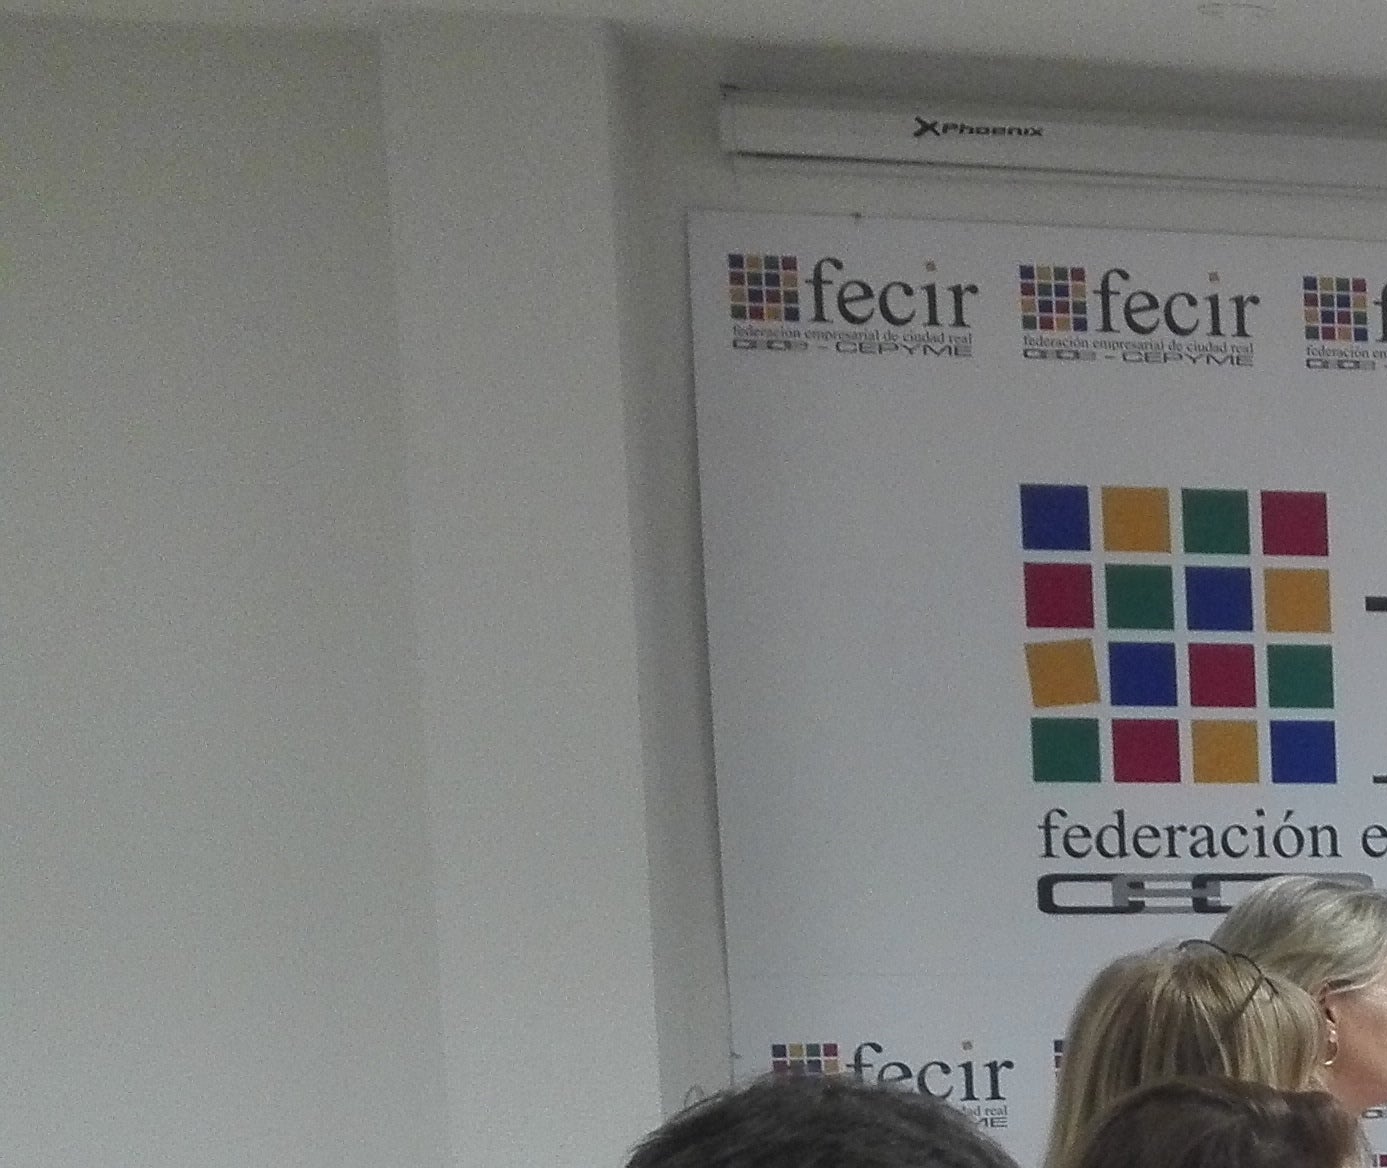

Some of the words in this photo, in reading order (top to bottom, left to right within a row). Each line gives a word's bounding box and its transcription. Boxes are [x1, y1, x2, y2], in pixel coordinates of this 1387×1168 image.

[804, 256, 980, 328] fecir
[1093, 268, 1260, 338] fecir
[1037, 807, 1342, 860] federación
